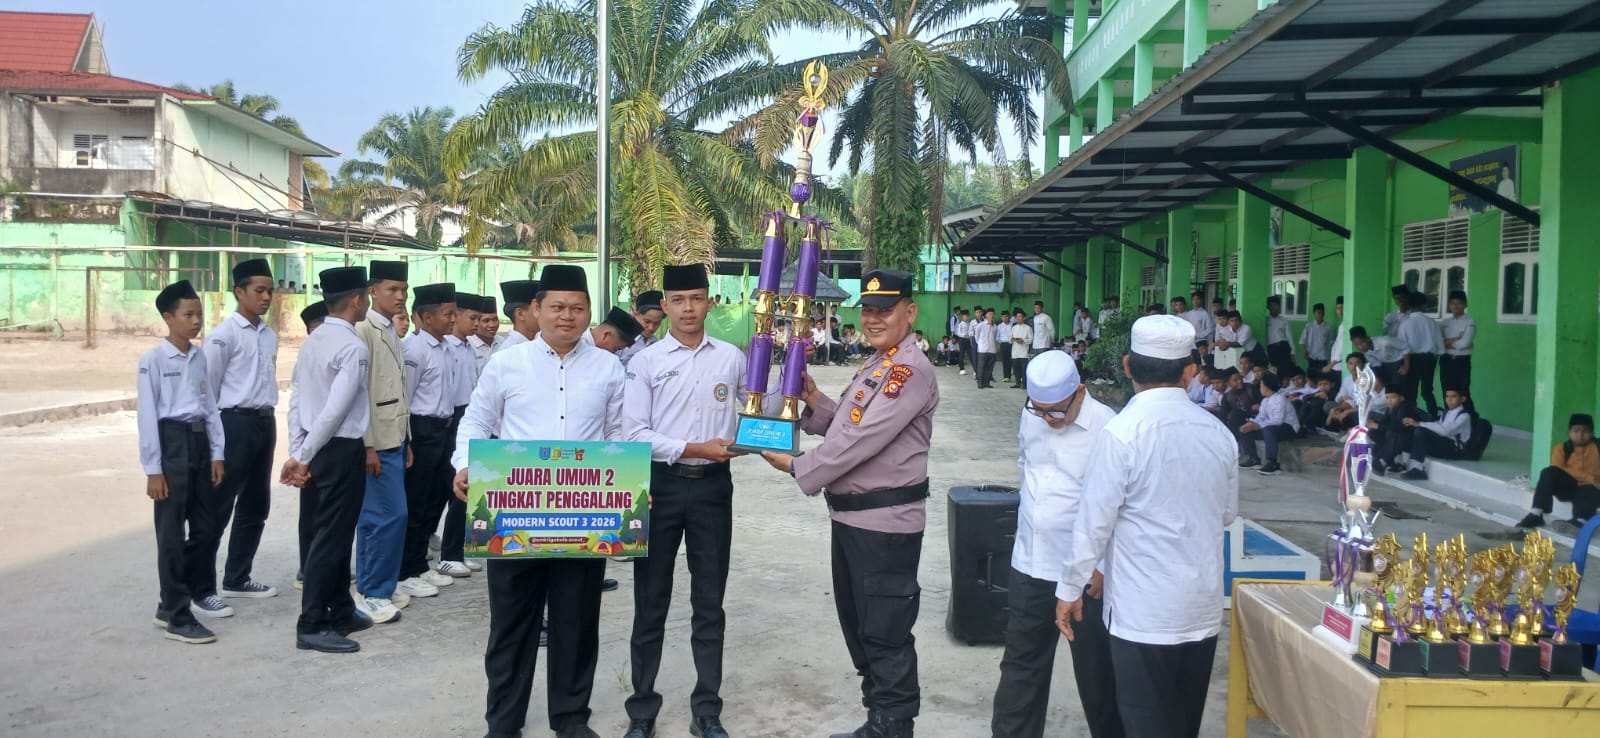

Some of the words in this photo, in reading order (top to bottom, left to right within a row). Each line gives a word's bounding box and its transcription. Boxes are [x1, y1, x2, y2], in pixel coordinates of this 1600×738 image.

[507, 468, 551, 486] JUARA
[556, 468, 601, 486] UMUM
[605, 469, 615, 486] 2
[487, 491, 542, 509] TINGKAT
[546, 491, 632, 509] PENGGALANG
[502, 517, 545, 527] MODERN
[548, 517, 578, 527] SCOUT
[582, 517, 587, 527] 3
[591, 517, 615, 527] 2026
